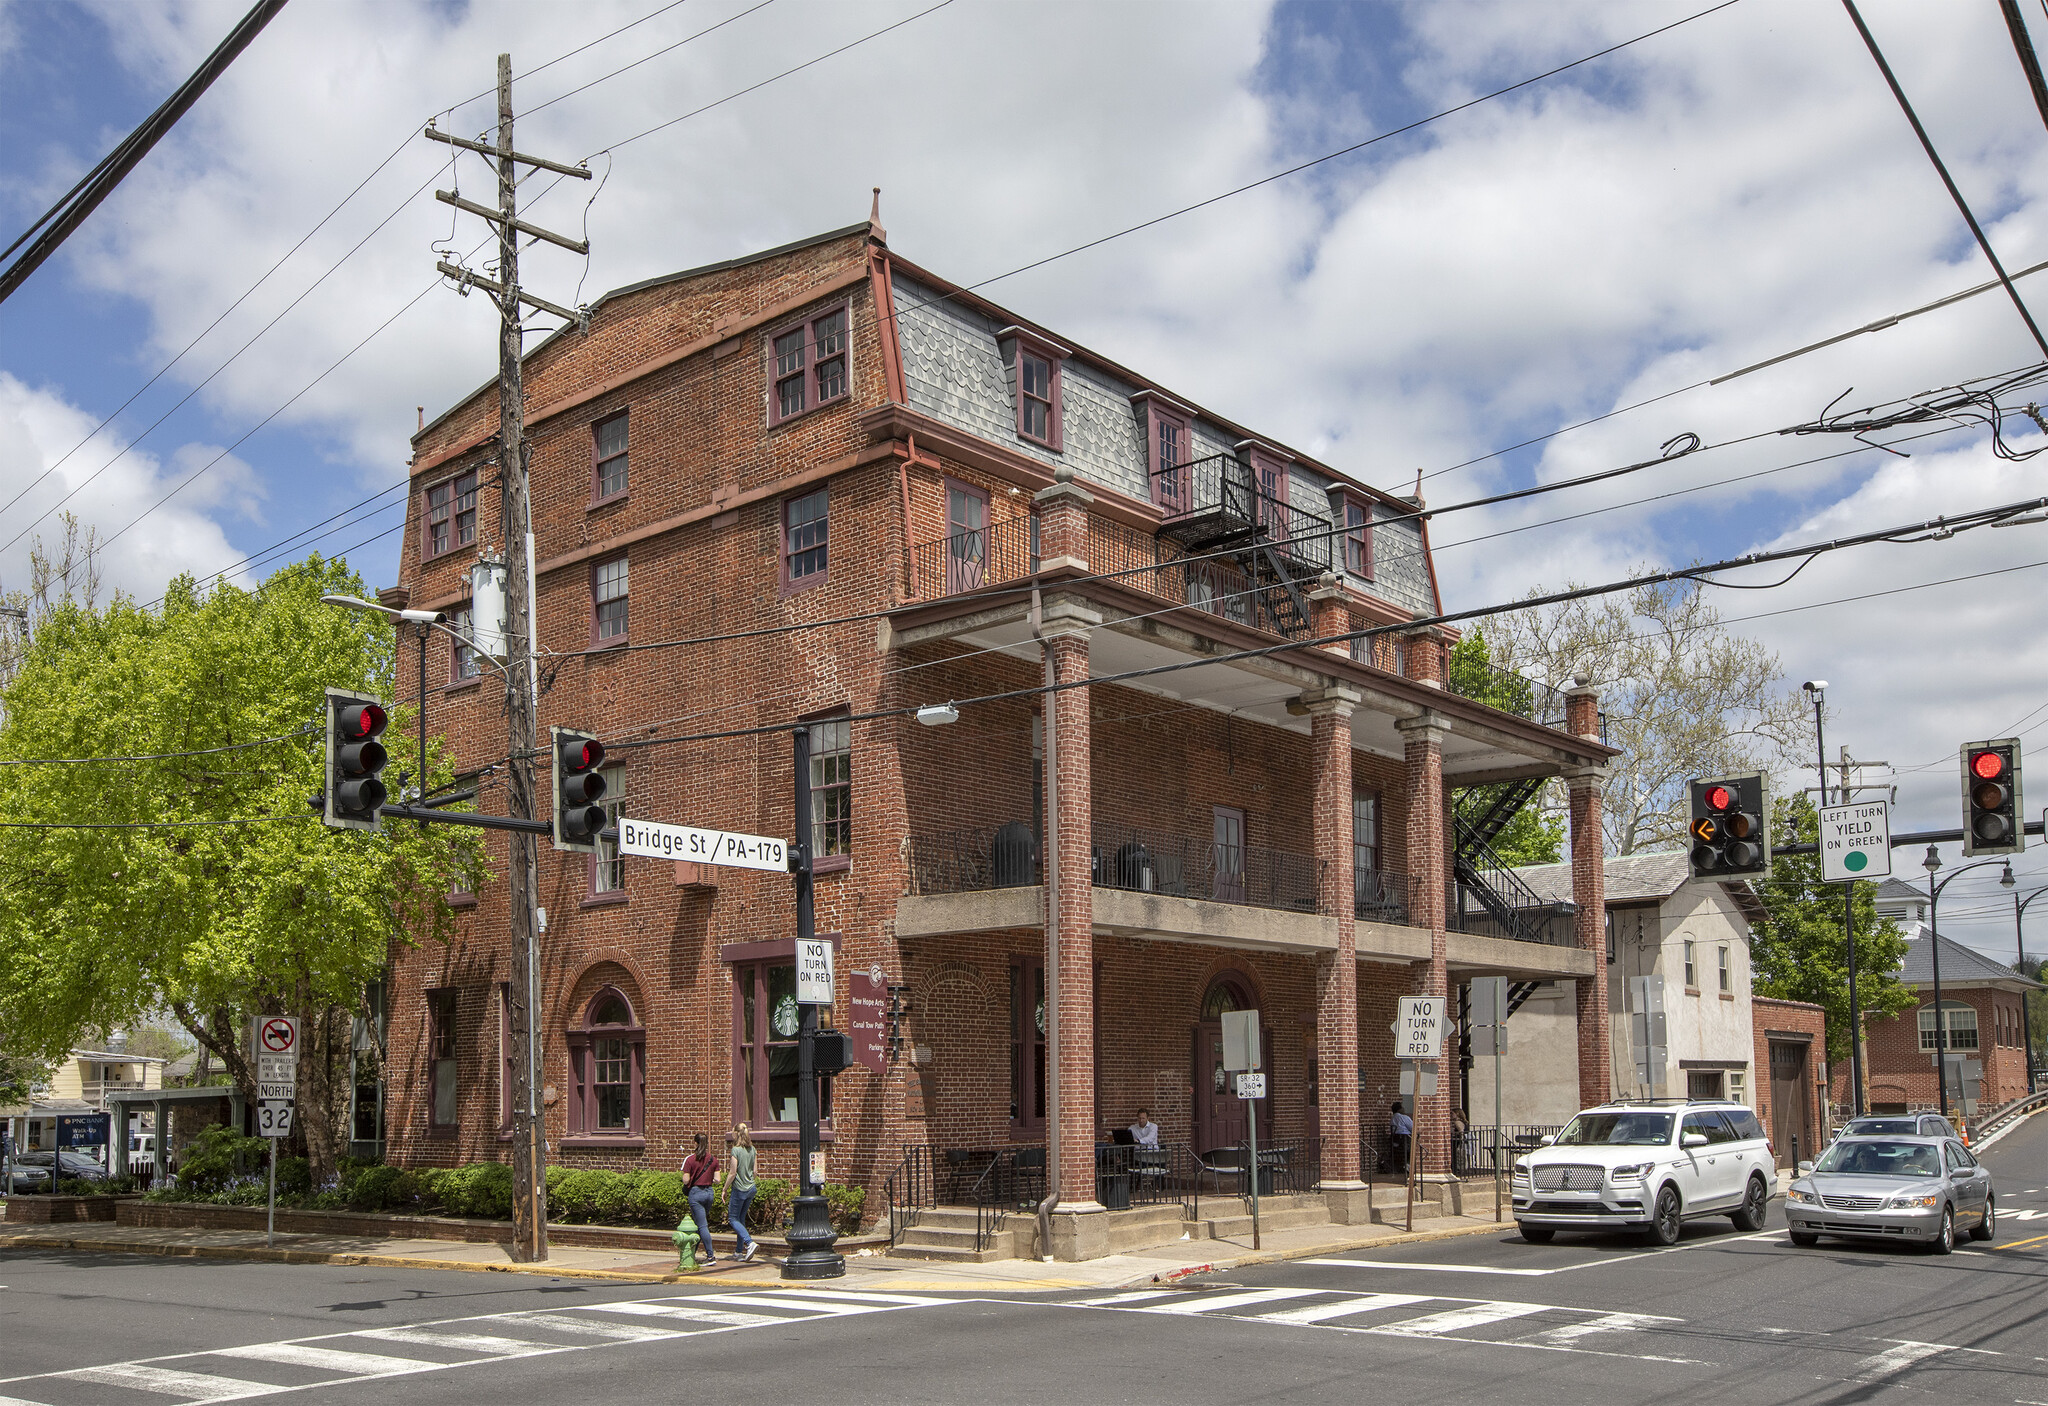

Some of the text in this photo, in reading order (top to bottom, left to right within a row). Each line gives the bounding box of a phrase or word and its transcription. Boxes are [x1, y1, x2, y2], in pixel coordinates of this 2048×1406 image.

[1823, 807, 1883, 822] LEFT TURN
[1836, 821, 1872, 836] YIELD
[625, 825, 683, 855] Bridge
[690, 833, 706, 854] St
[727, 838, 782, 863] PA-179
[1827, 835, 1883, 850] ON GREEN
[807, 945, 823, 957] NO
[805, 960, 826, 969] TURN
[800, 971, 831, 983] ON RED
[852, 996, 885, 1007] New Hope Arts
[1413, 1002, 1432, 1016] NO
[852, 1020, 885, 1030] Canal Tow Path
[1407, 1018, 1435, 1028] TURN
[1413, 1031, 1427, 1041] ON
[868, 1043, 885, 1052] Parking
[1408, 1043, 1429, 1053] RED
[261, 1084, 293, 1097] NORTH
[1244, 1082, 1256, 1090] 360
[262, 1109, 289, 1129] 32
